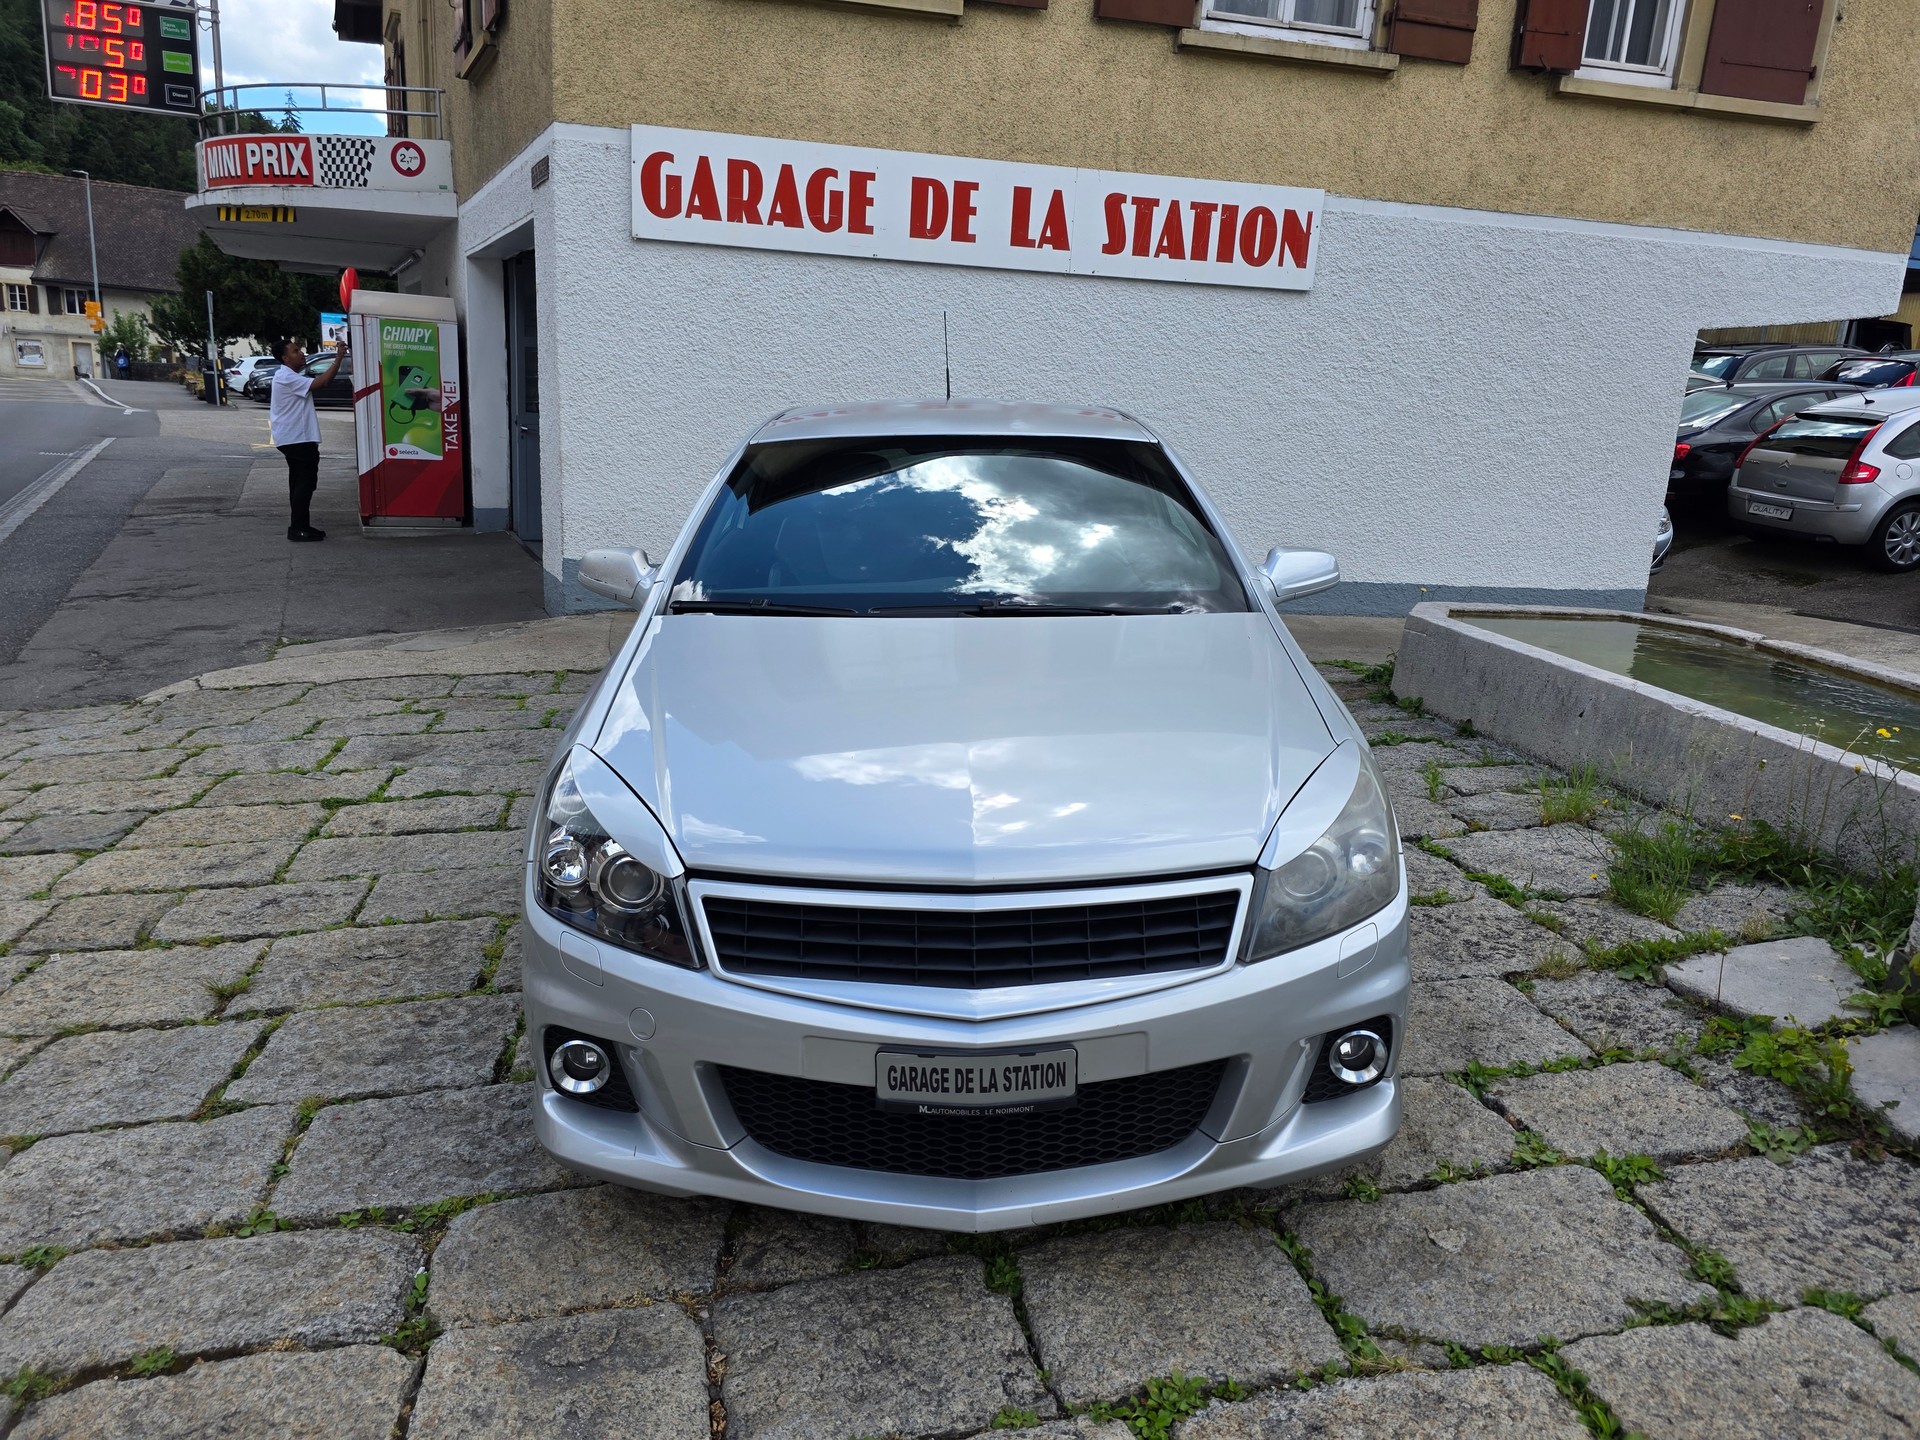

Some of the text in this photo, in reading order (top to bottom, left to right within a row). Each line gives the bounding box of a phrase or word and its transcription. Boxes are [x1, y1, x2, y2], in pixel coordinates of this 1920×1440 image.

[206, 141, 309, 180] MINI PRIX
[640, 151, 1314, 270] GARAGE DE LA STATION
[383, 326, 433, 344] CHIMPY
[443, 381, 459, 452] TAKE ME!
[887, 1061, 1067, 1094] GARAGE DE LA STATION
[996, 1105, 1035, 1115] NOIRMONT
